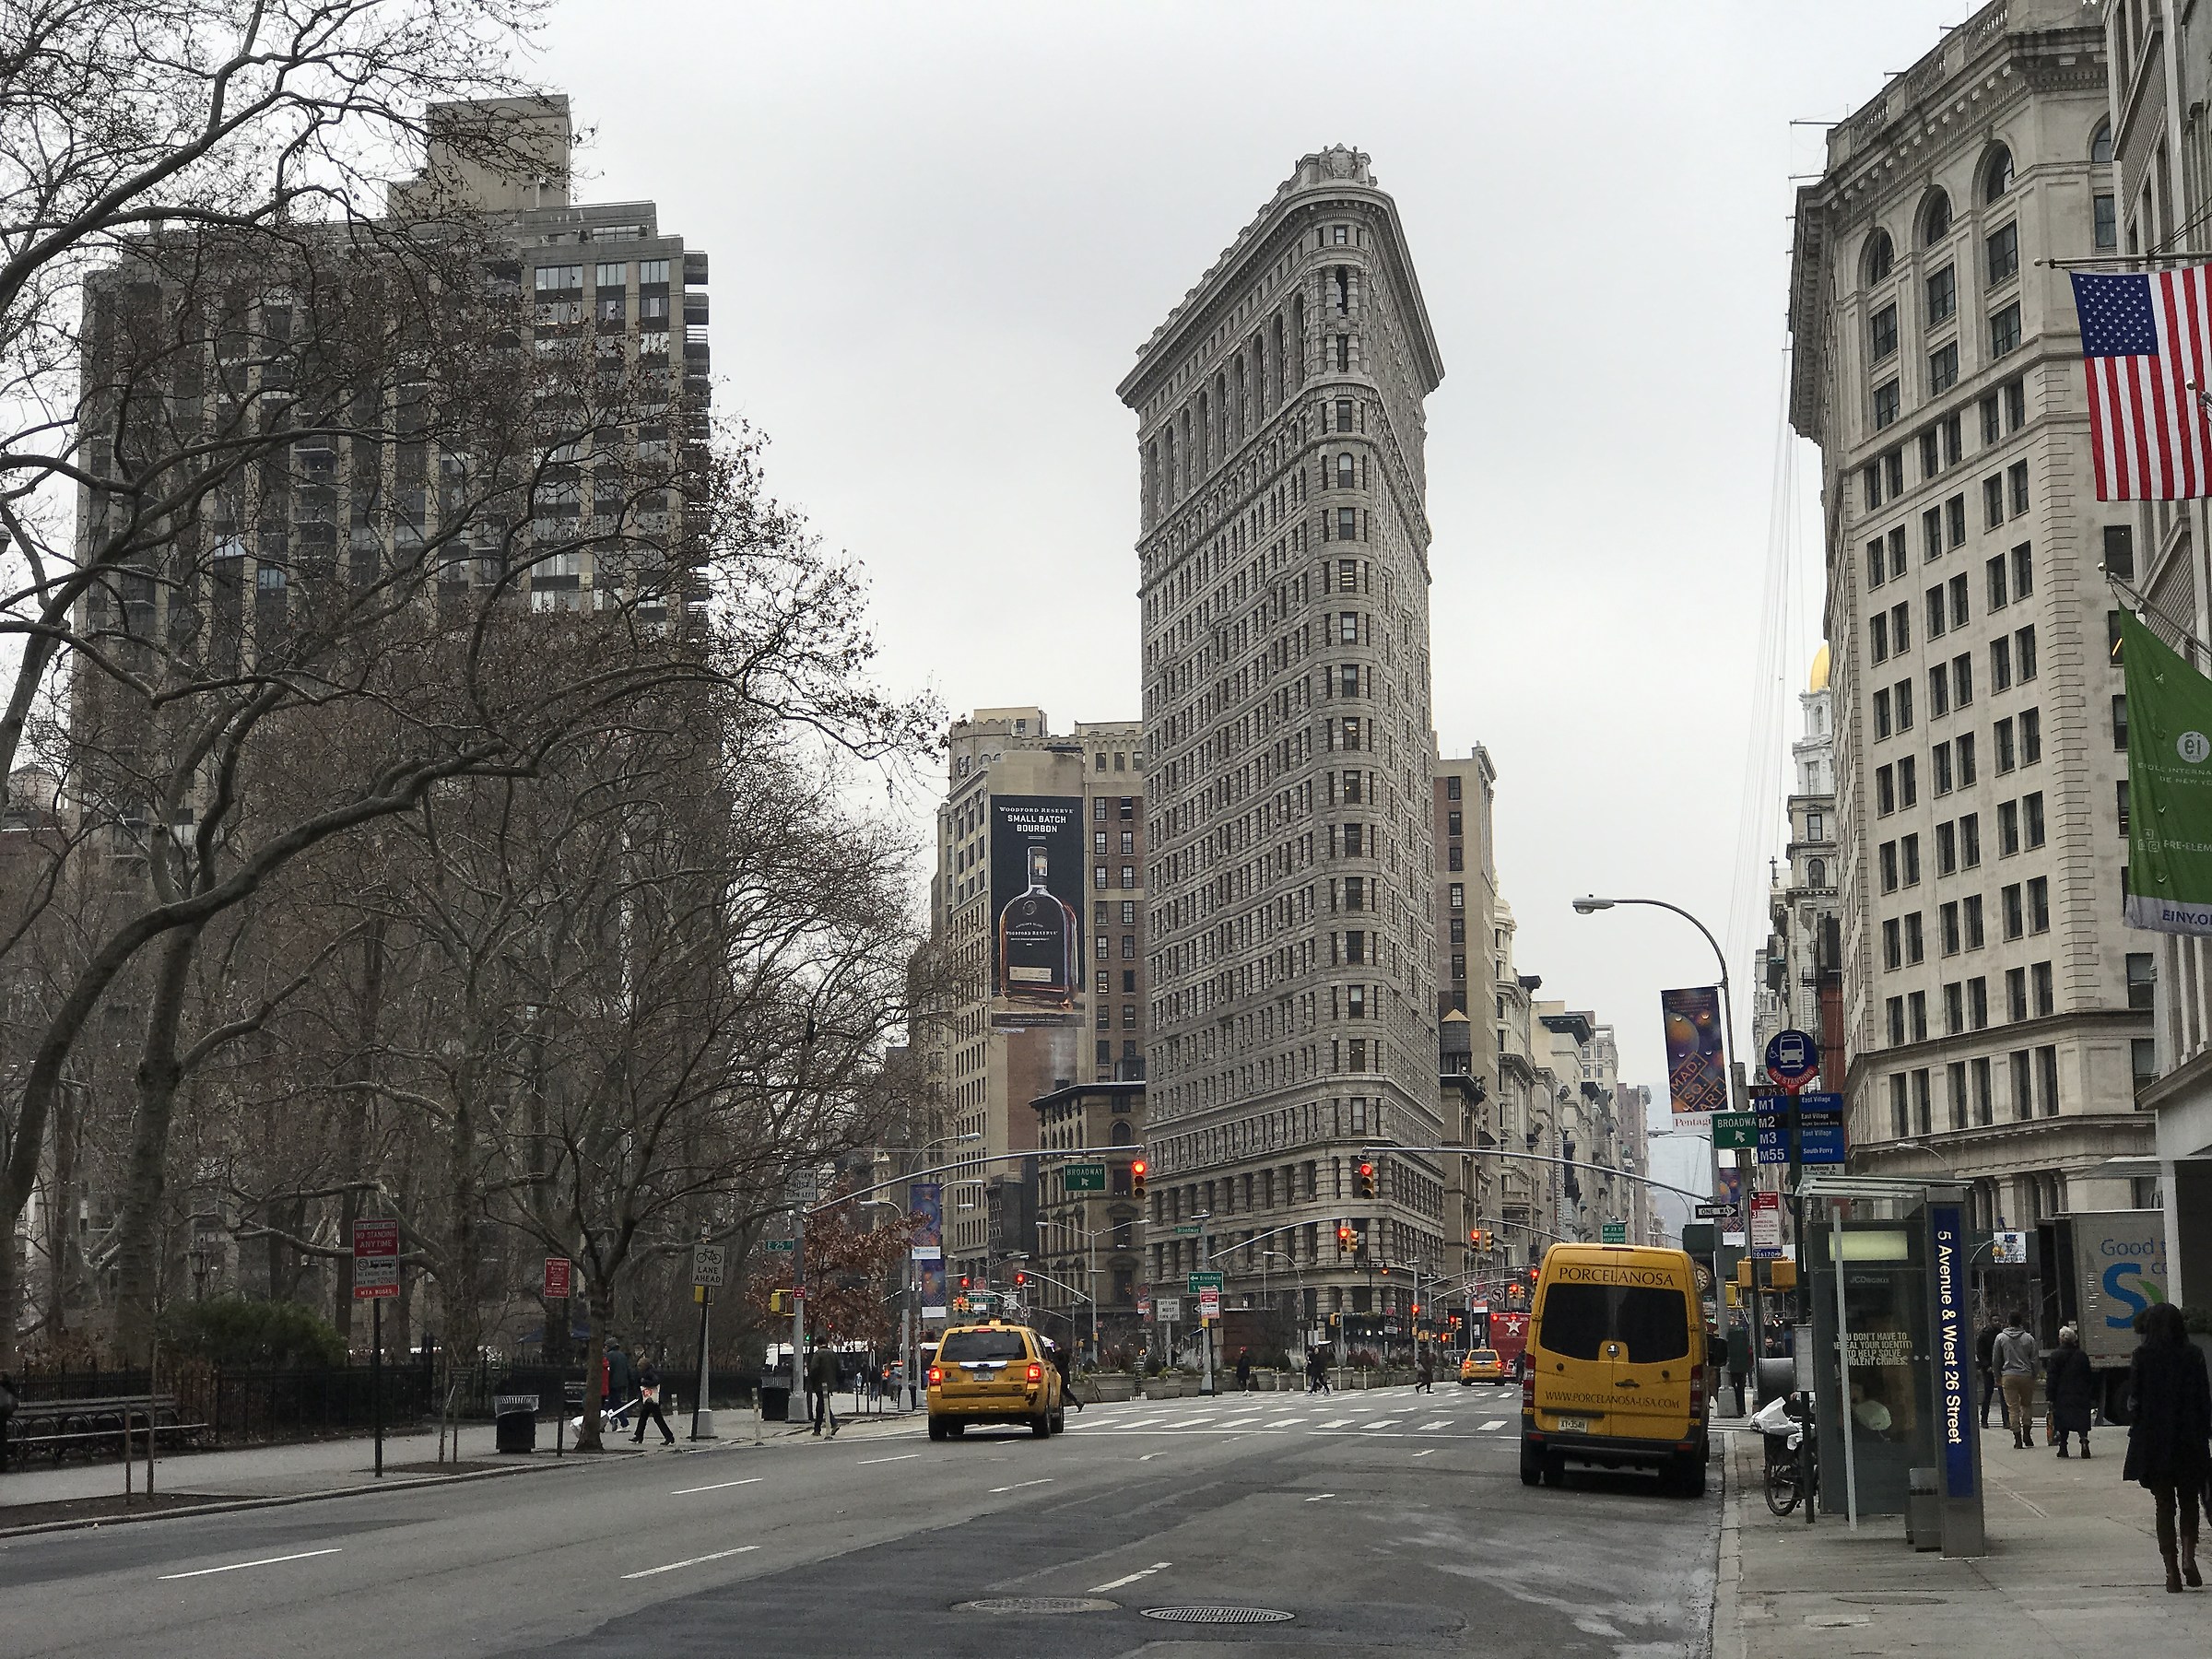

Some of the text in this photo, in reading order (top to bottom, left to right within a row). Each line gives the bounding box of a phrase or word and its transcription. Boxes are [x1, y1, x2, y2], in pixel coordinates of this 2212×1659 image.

[1007, 814, 1066, 824] SMALL BATCH
[1017, 824, 1058, 833] BOURBON
[1671, 1061, 1701, 1091] MAD.
[1771, 1069, 1815, 1085] NO STANDING
[1759, 1098, 1774, 1111] M1
[1717, 1118, 1757, 1128] BROADWA
[1759, 1116, 1775, 1128] M2
[1759, 1132, 1777, 1144] M3
[1760, 1148, 1785, 1161] M55
[1066, 1168, 1103, 1176] BROADWAY
[367, 1230, 396, 1239] STANDING
[359, 1241, 393, 1249] ANYTIME
[767, 1241, 772, 1250] E
[775, 1241, 784, 1250] 25
[2100, 1237, 2154, 1256] Good
[694, 1275, 721, 1283] AHEAD
[1559, 1267, 1675, 1287] PORCELANOSA
[1850, 1276, 1890, 1284] JCDecaux
[1836, 1332, 1907, 1341] YU DON'T HAVE TO
[1937, 1230, 1962, 1444] 5 Avenue & West 26 Street
[1860, 1341, 1880, 1349] YOUR
[1847, 1348, 1901, 1358] TO HELP SOLVE
[1848, 1357, 1875, 1366] IOLENT
[1545, 1390, 1679, 1409] WWW.PORCELANOSA-USA.COM
